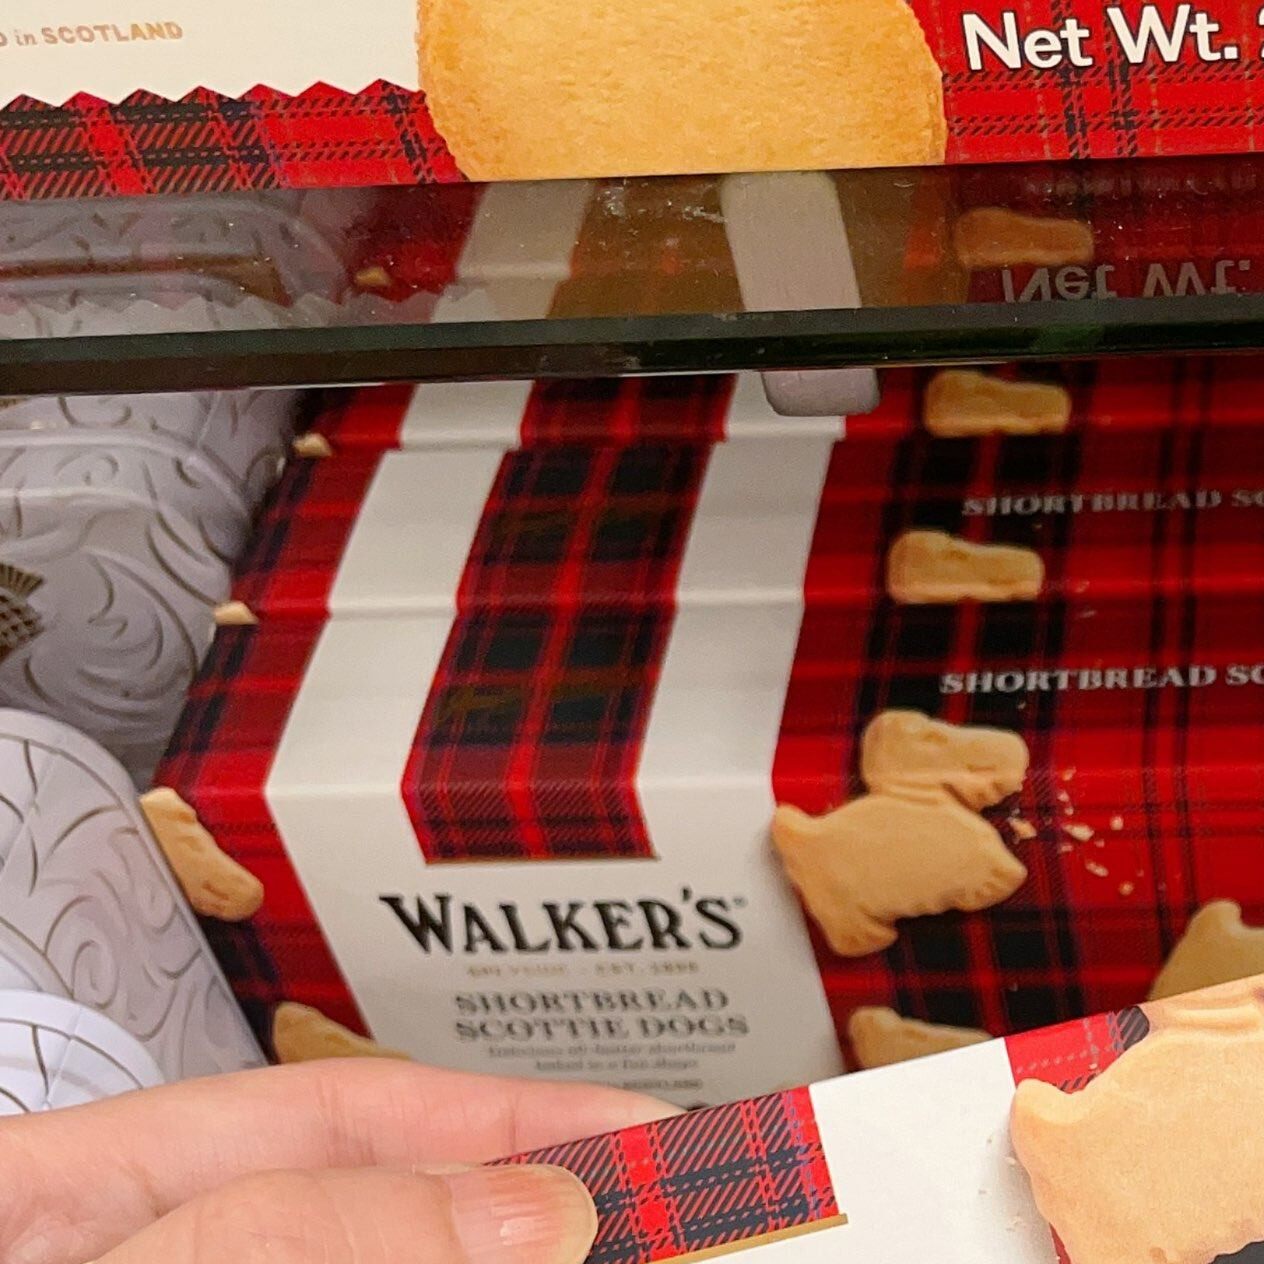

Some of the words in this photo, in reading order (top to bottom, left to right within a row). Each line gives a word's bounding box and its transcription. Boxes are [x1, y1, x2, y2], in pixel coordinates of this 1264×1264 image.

[15, 28, 38, 47] in
[41, 21, 184, 45] SCOTLAND
[961, 11, 1094, 71] Net
[1106, 3, 1240, 65] Wt.
[962, 489, 1222, 517] SHORTBREAD
[939, 665, 1217, 694] SHORTBREAD
[379, 886, 746, 955] WALKER'S
[454, 987, 730, 1016] SHORTBREAD
[454, 1017, 630, 1041] SCOTTIE
[637, 1013, 749, 1038] DOGS
